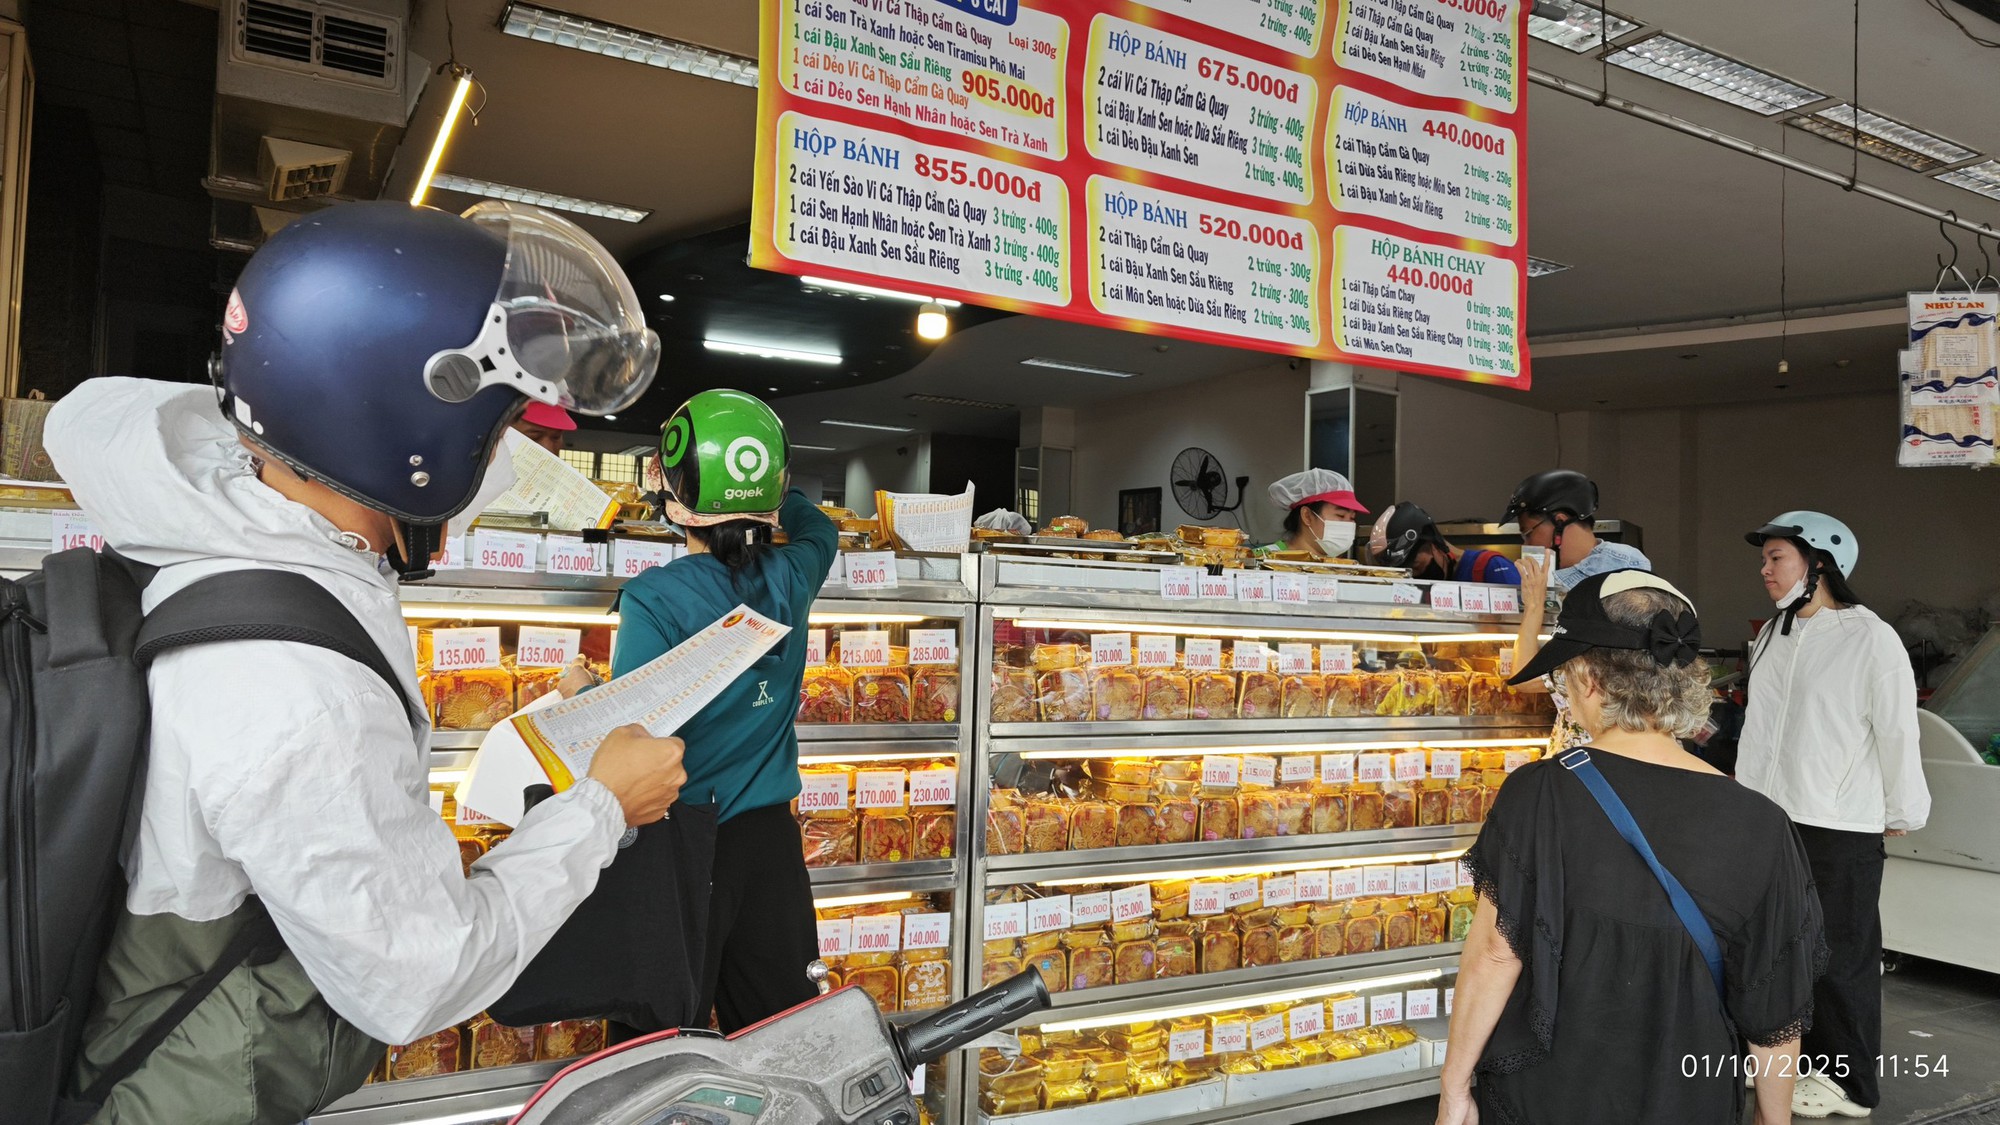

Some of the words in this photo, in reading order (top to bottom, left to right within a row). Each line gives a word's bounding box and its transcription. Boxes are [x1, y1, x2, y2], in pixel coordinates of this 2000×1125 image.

[805, 2, 821, 18] cái
[825, 4, 846, 23] Sen
[850, 11, 867, 30] Trà
[870, 19, 895, 40] Xanh
[900, 22, 924, 49] hoặc
[928, 34, 944, 53] Sen
[947, 41, 987, 67] Tiramisu
[990, 50, 1006, 74] Phô
[1009, 62, 1025, 80] Mai
[1009, 31, 1029, 53] Loại
[1032, 39, 1057, 59] 300g
[794, 23, 800, 39] 1
[804, 28, 821, 44] cái
[825, 30, 847, 52] Đậu
[851, 36, 876, 58] Xanh
[879, 46, 896, 67] Sen
[900, 51, 920, 71] Sầu
[924, 57, 951, 82] Riêng
[1108, 30, 1141, 57] HỘP
[1145, 40, 1187, 70] BÁNH
[1197, 57, 1299, 103] 675.000đ
[961, 70, 1054, 118] 905.000đ
[1098, 66, 1105, 85] 2
[1108, 69, 1121, 89] cái
[1124, 71, 1133, 92] Vi
[1136, 77, 1148, 96] Cá
[1151, 79, 1171, 105] Thập
[1174, 83, 1193, 108] Cẩm
[1196, 91, 1206, 112] Gà
[1209, 95, 1229, 121] Quay
[793, 73, 799, 89] 1
[804, 78, 823, 95] cái
[856, 87, 879, 107] Sen
[884, 91, 911, 118] Hạnh
[915, 100, 946, 125] Nhân
[950, 108, 976, 136] hoặc
[979, 121, 998, 139] Sen
[1002, 126, 1019, 146] Trà
[1023, 132, 1048, 152] Xanh
[1249, 107, 1255, 124] 3
[1258, 109, 1278, 135] trứng
[1285, 116, 1304, 141] 400g
[1345, 101, 1368, 126] HỘP
[1371, 110, 1407, 133] BÁNH
[1423, 120, 1505, 155] 440.000đ
[1343, 138, 1354, 152] cái
[1356, 139, 1377, 158] Thập
[1379, 141, 1397, 159] Cẩm
[1399, 145, 1409, 160] Gà
[1412, 148, 1429, 166] Quay
[793, 127, 836, 156] HỘP
[843, 138, 900, 170] BÁNH
[914, 153, 1041, 202] 855.000đ
[790, 164, 797, 184] 2
[800, 168, 816, 187] cái
[843, 175, 863, 197] Sào
[867, 180, 877, 199] Vi
[880, 182, 892, 202] Cá
[896, 185, 921, 212] Thập
[925, 190, 944, 214] Cẩm
[948, 198, 959, 218] Gà
[963, 203, 987, 225] Quay
[993, 206, 999, 225] 3
[1002, 209, 1026, 236] trứng
[1035, 216, 1057, 240] 400g
[1105, 191, 1138, 220] HỘP
[1143, 200, 1187, 228] BÁNH
[1199, 214, 1303, 251] 520.000đ
[789, 222, 795, 241] 1
[800, 227, 818, 245] cái
[822, 230, 845, 252] Đậu
[849, 234, 877, 256] Xanh
[881, 240, 901, 261] Sen
[905, 239, 925, 266] Sầu
[929, 249, 960, 274] Riêng
[1099, 226, 1105, 242] 2
[1108, 230, 1122, 246] cái
[1124, 233, 1147, 255] Thập
[1150, 236, 1170, 256] Cẩm
[1173, 242, 1184, 259] Gà
[1187, 245, 1208, 265] Quay
[1371, 238, 1399, 260] HỘP
[1403, 245, 1444, 268] BÁNH
[1447, 256, 1485, 275] CHAY
[1248, 256, 1254, 270] 2
[1256, 256, 1281, 277] trứng
[1290, 262, 1311, 282] 300g
[1387, 264, 1473, 296] 440.000đ
[1924, 301, 1954, 310] NHƯ
[724, 486, 764, 500] gojek
[482, 550, 524, 568] 95.000
[551, 555, 593, 572] 120.000
[852, 568, 885, 584] 95.000
[1164, 584, 1189, 596] 120.000
[1201, 584, 1227, 596] 120.000
[1277, 589, 1300, 600] 155.000
[1465, 600, 1483, 610] 95.000
[439, 648, 485, 666] 135.000
[520, 647, 564, 663] 135.000
[842, 649, 882, 664] 215.000
[913, 647, 949, 661] 285.000
[1095, 650, 1122, 663] 150.000
[1140, 651, 1166, 663] 150.000
[1187, 654, 1212, 666] 150.000
[1235, 657, 1259, 668] 135.000
[1323, 660, 1345, 670] 135.000
[1205, 771, 1230, 782] 115.000
[801, 792, 839, 807] 155.000
[860, 789, 897, 804] 170.000
[914, 788, 949, 802] 230.000
[1300, 885, 1322, 897] 85.000
[1116, 901, 1143, 918] 125.000
[1194, 899, 1217, 911] 85.000
[988, 921, 1017, 936] 155.000
[1034, 913, 1061, 929] 170.000
[858, 934, 889, 948] 100.000
[908, 930, 939, 946] 140.000
[1375, 1008, 1395, 1020] 75.000
[1410, 1004, 1429, 1016] 105.000
[1295, 1019, 1317, 1035] 75.000
[1337, 1013, 1357, 1027] 75.000
